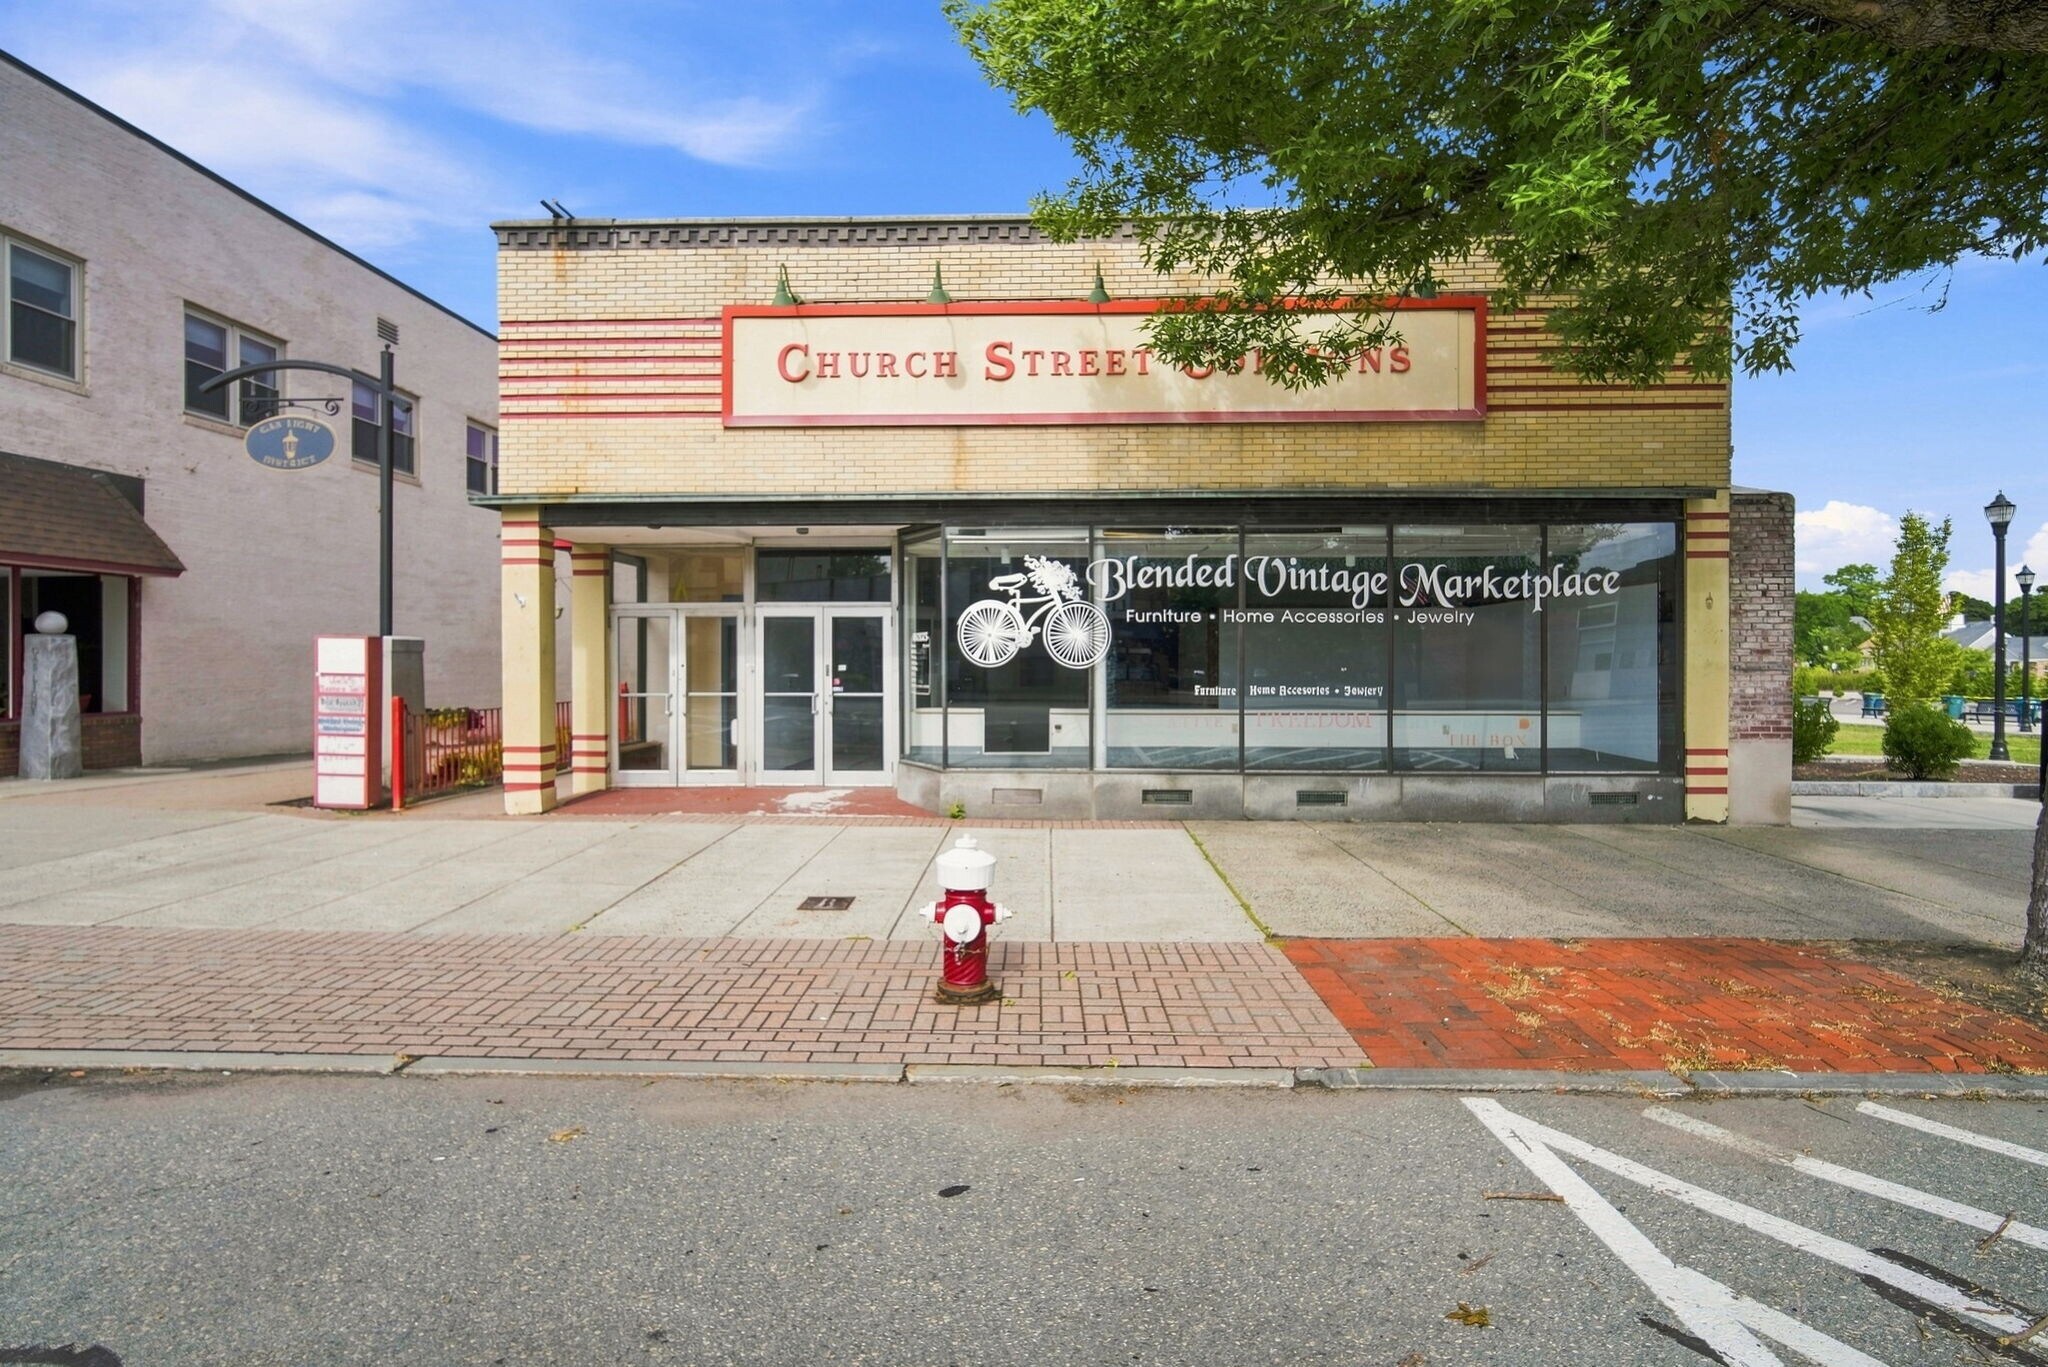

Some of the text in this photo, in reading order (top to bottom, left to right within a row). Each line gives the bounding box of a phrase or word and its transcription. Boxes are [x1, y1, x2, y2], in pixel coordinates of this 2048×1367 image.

[777, 343, 958, 383] CHURCH
[984, 340, 1156, 382] STREET
[1085, 554, 1621, 613] Blended Vintage Marketplace
[1126, 609, 1475, 626] Furniture Home Accessories Jewelry
[1194, 685, 1237, 696] Furniture
[1249, 685, 1276, 696] Home
